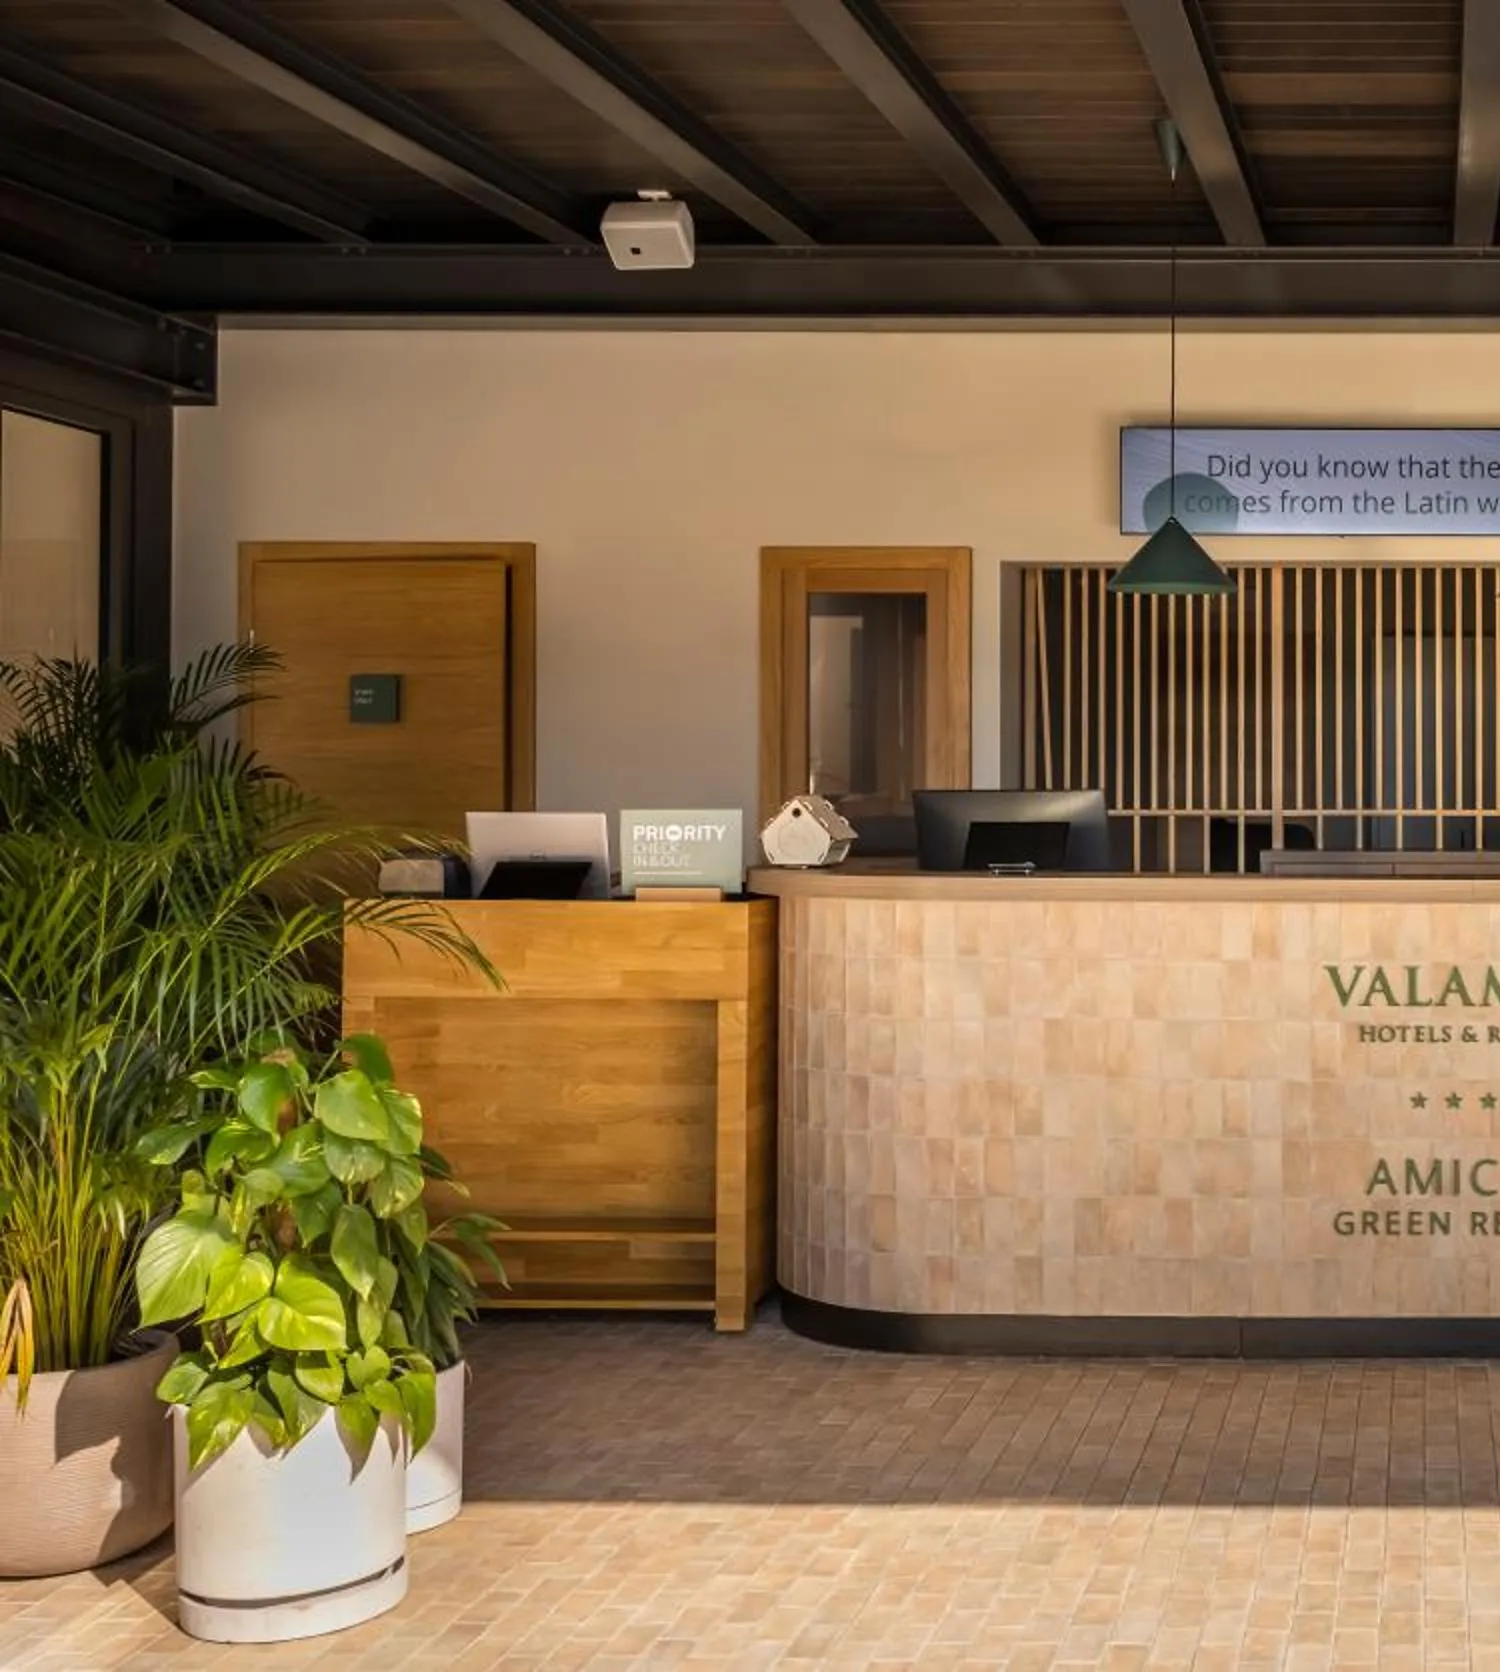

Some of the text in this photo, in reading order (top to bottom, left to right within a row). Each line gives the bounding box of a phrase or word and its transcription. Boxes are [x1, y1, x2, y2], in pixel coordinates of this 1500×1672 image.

[1207, 454, 1251, 477] Did
[1259, 459, 1308, 484] you
[1318, 454, 1389, 478] know
[1398, 454, 1451, 479] that
[1184, 494, 1271, 514] comes
[1280, 489, 1343, 514] from
[1352, 489, 1395, 514] the
[1405, 490, 1469, 515] Latin
[633, 824, 726, 842] PRIORITY
[1358, 1025, 1452, 1044] HOTELS
[1460, 1025, 1479, 1043] &
[1333, 1211, 1452, 1237] GREEN
